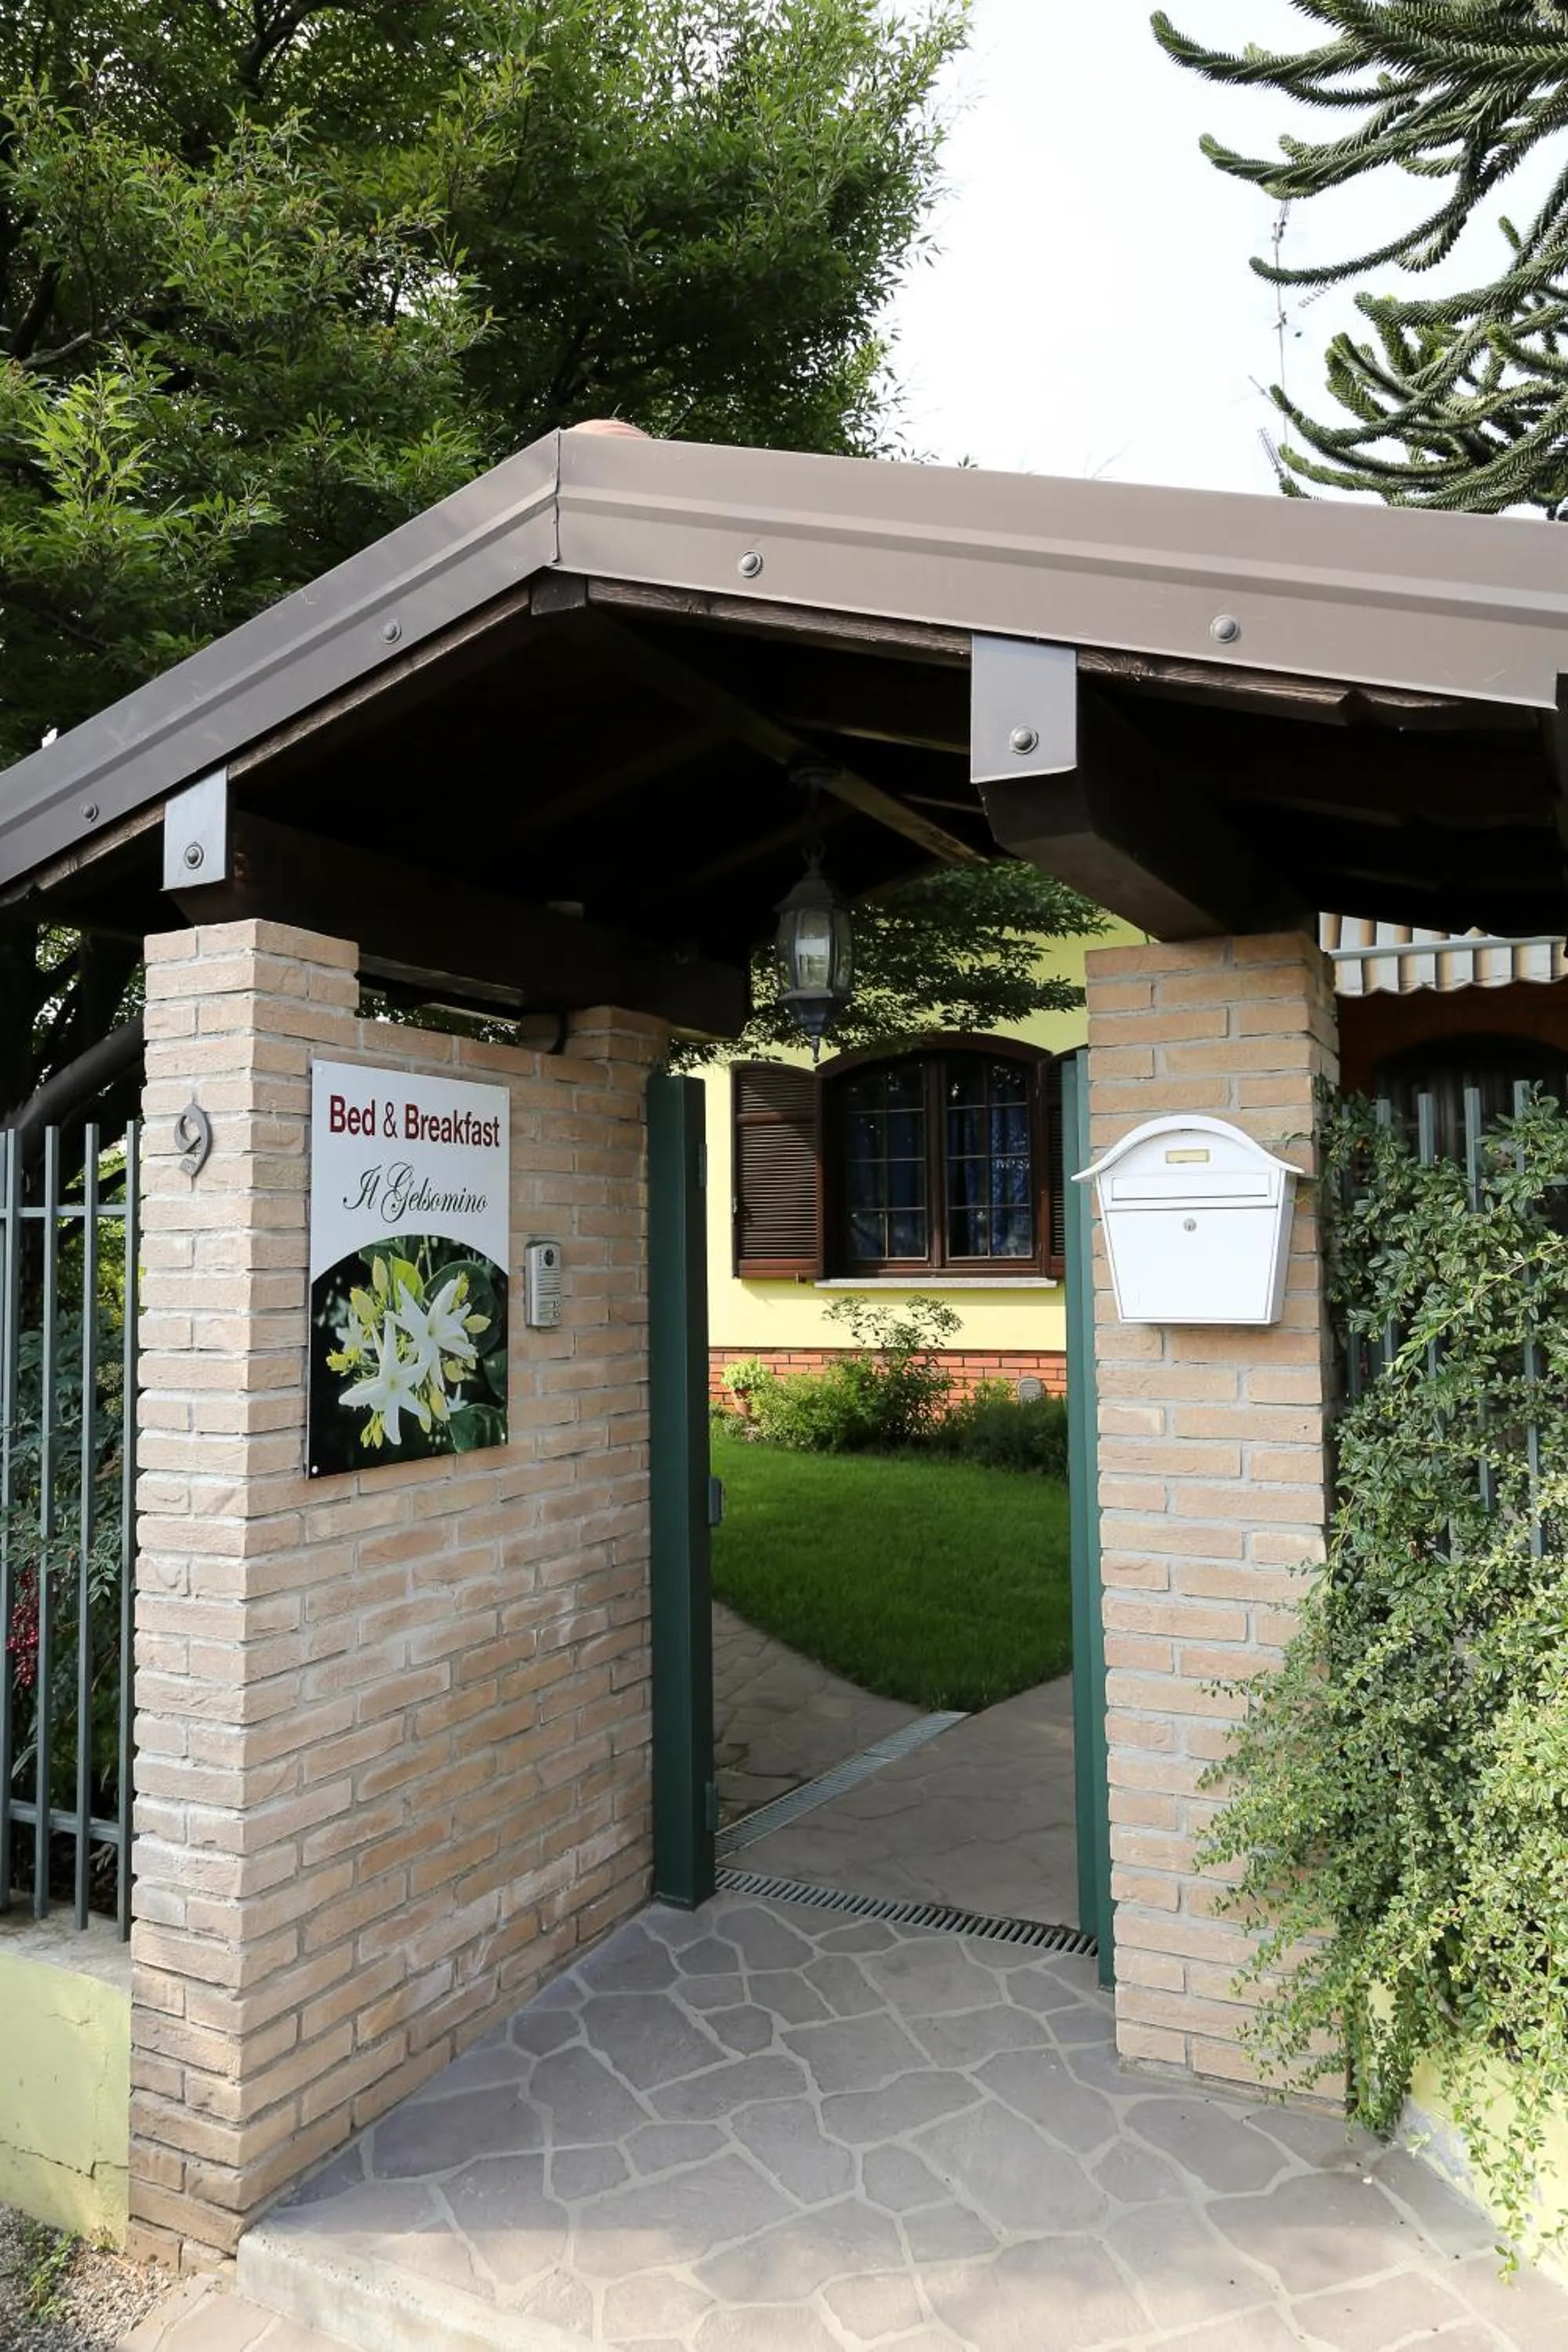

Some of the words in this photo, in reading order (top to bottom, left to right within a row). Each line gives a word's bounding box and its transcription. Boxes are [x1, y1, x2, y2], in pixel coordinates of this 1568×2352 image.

[174, 1103, 212, 1178] 9
[329, 1094, 376, 1136] Bed
[383, 1102, 397, 1138] &
[405, 1103, 500, 1148] Breakfast
[343, 1164, 382, 1210] Il
[381, 1162, 488, 1223] Gelsomino
